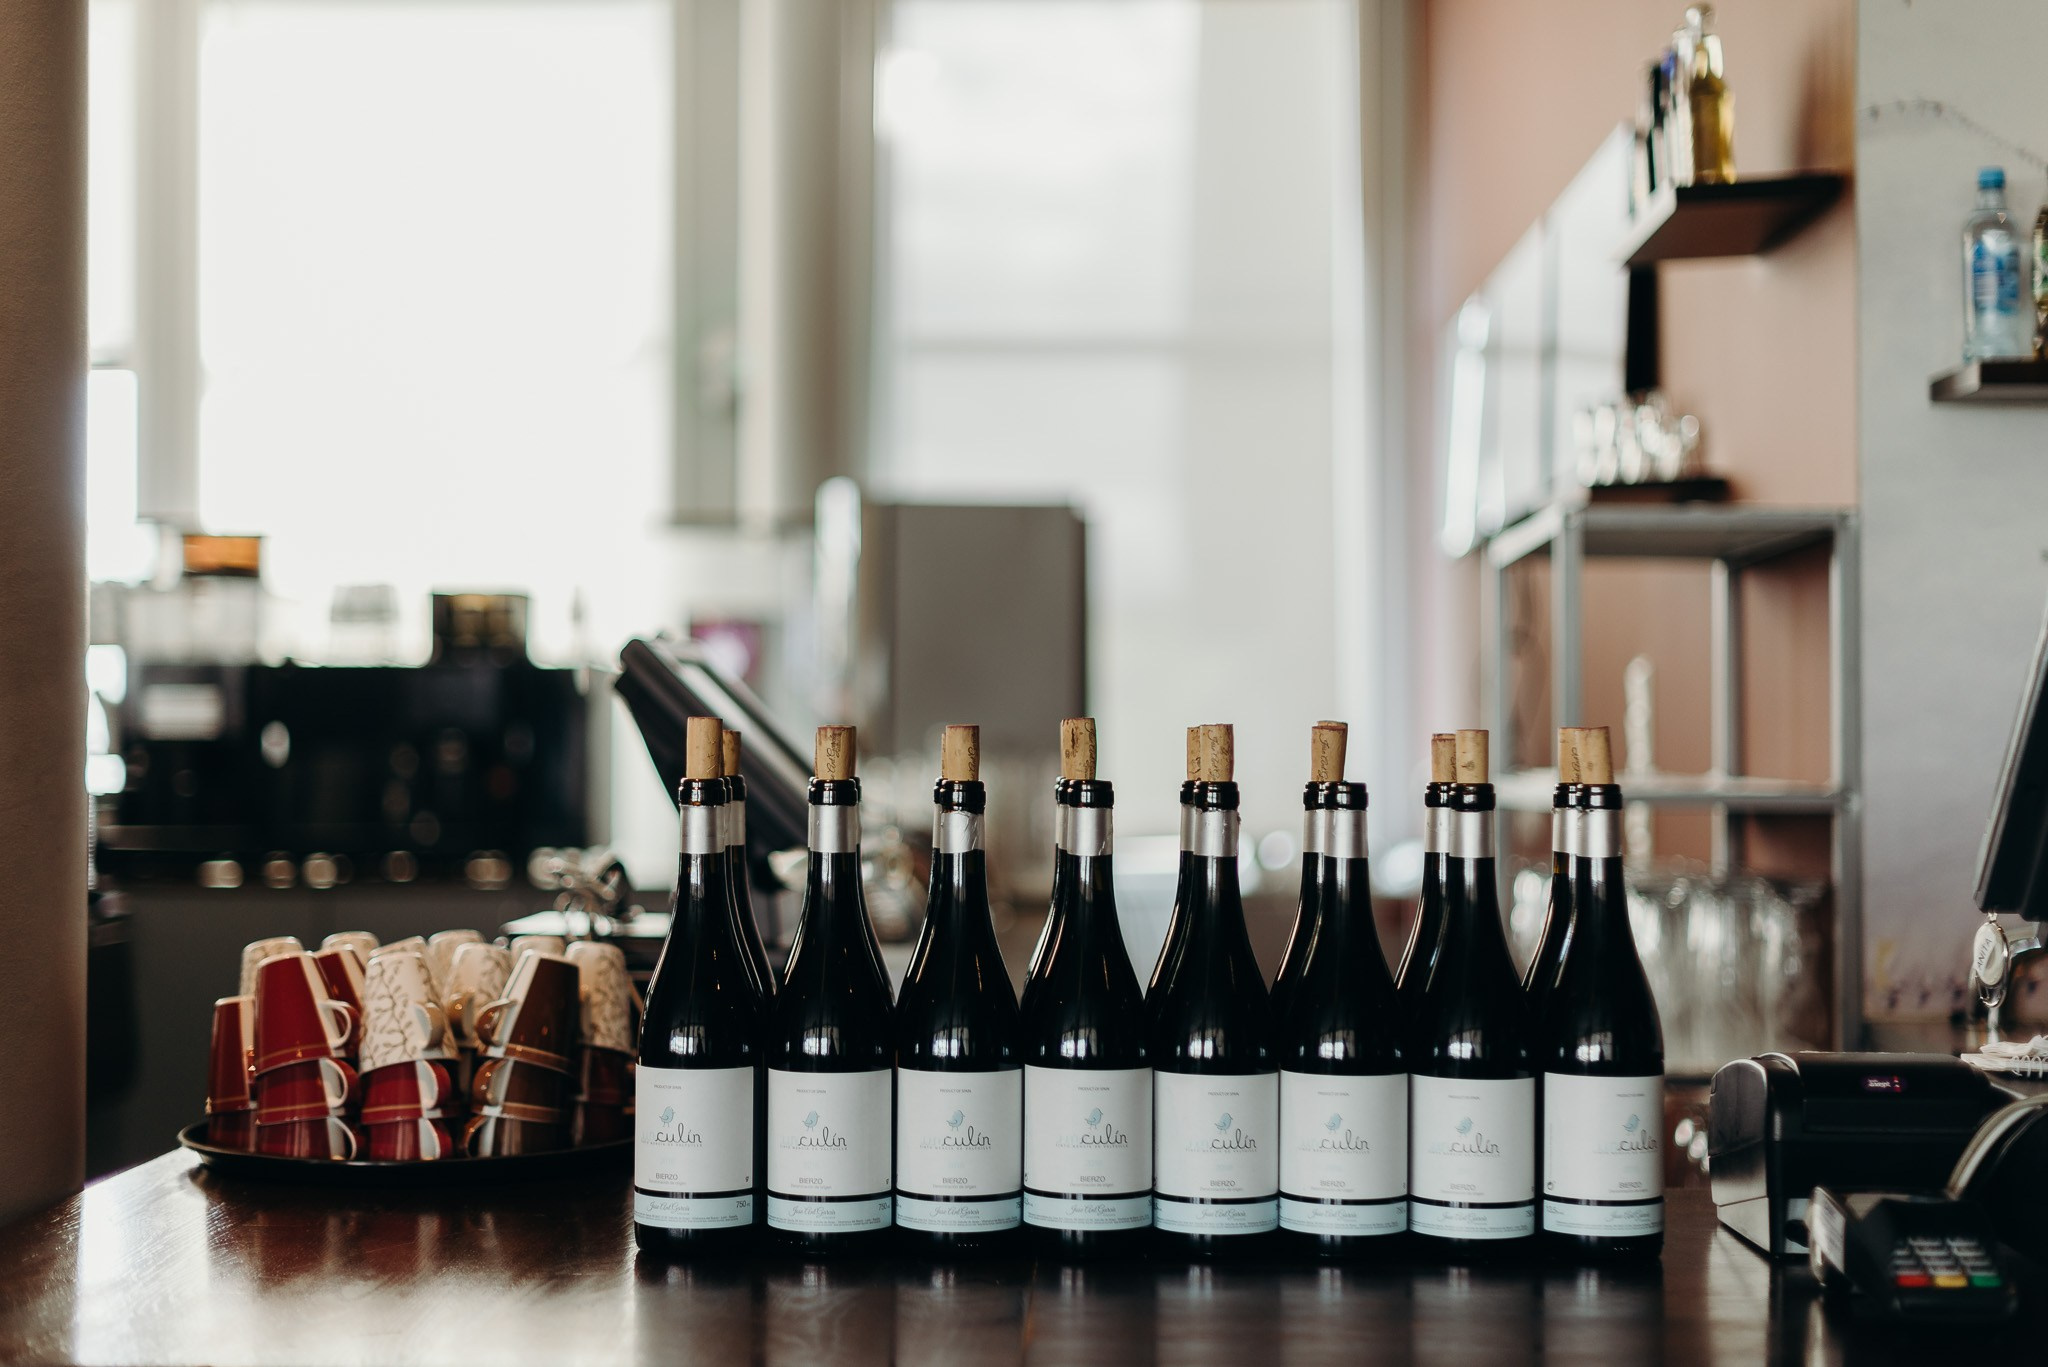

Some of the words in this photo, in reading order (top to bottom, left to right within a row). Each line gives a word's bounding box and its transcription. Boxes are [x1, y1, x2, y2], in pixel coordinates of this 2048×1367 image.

[655, 1172, 678, 1180] BIERZO
[1080, 1175, 1106, 1183] BIERZO
[1210, 1179, 1236, 1187] BIERZO
